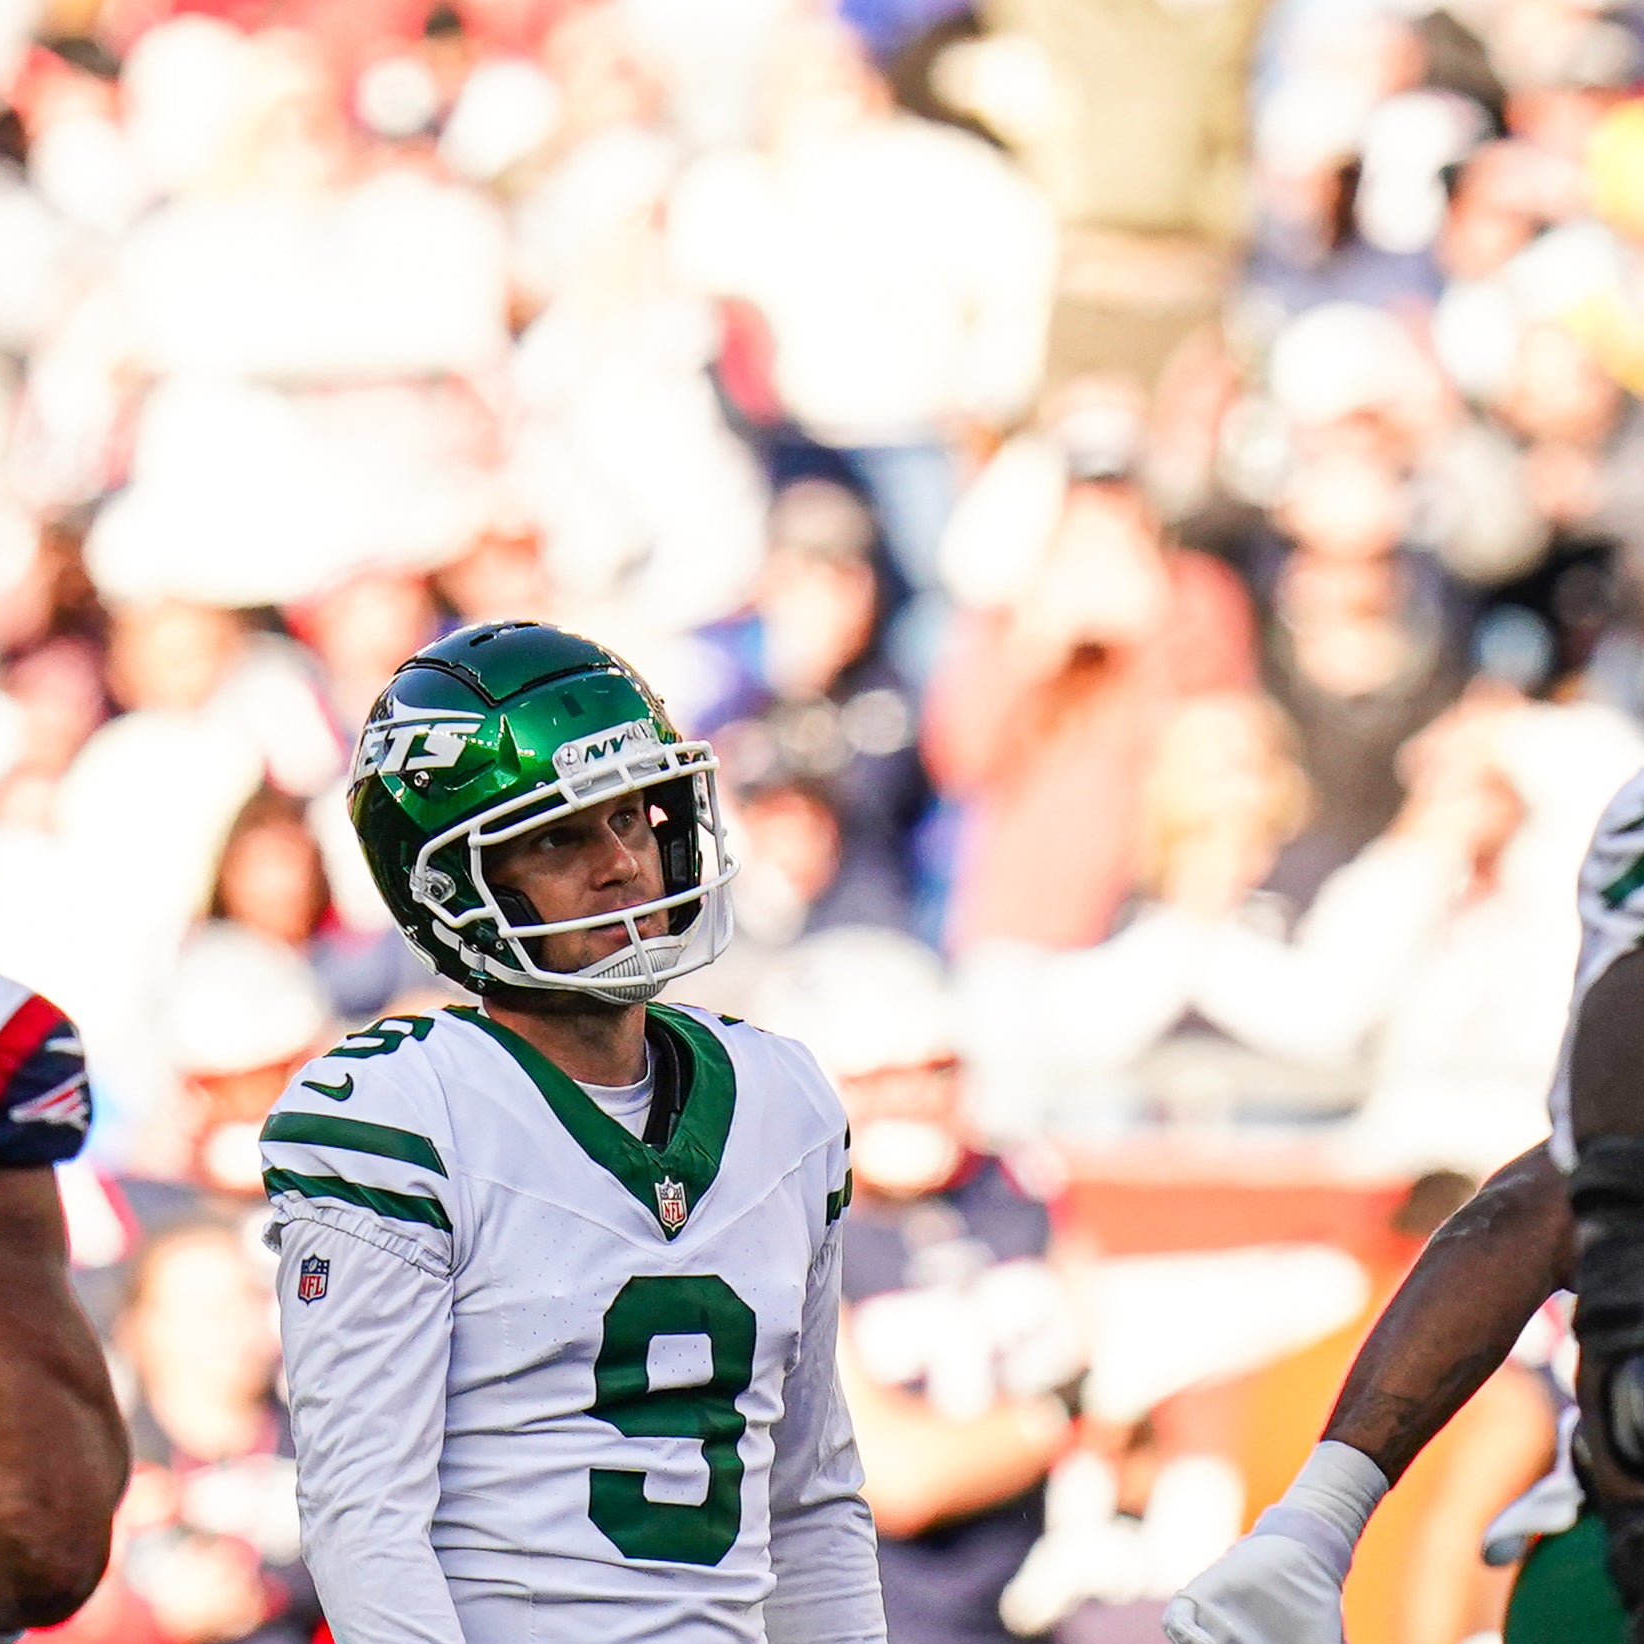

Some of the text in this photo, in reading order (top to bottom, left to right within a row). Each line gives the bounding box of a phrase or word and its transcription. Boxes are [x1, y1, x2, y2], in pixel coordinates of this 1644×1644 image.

[353, 696, 485, 780] ETS
[584, 733, 628, 764] NY
[662, 1201, 685, 1221] NFL
[300, 1275, 324, 1299] NFL
[583, 1274, 757, 1567] 9
